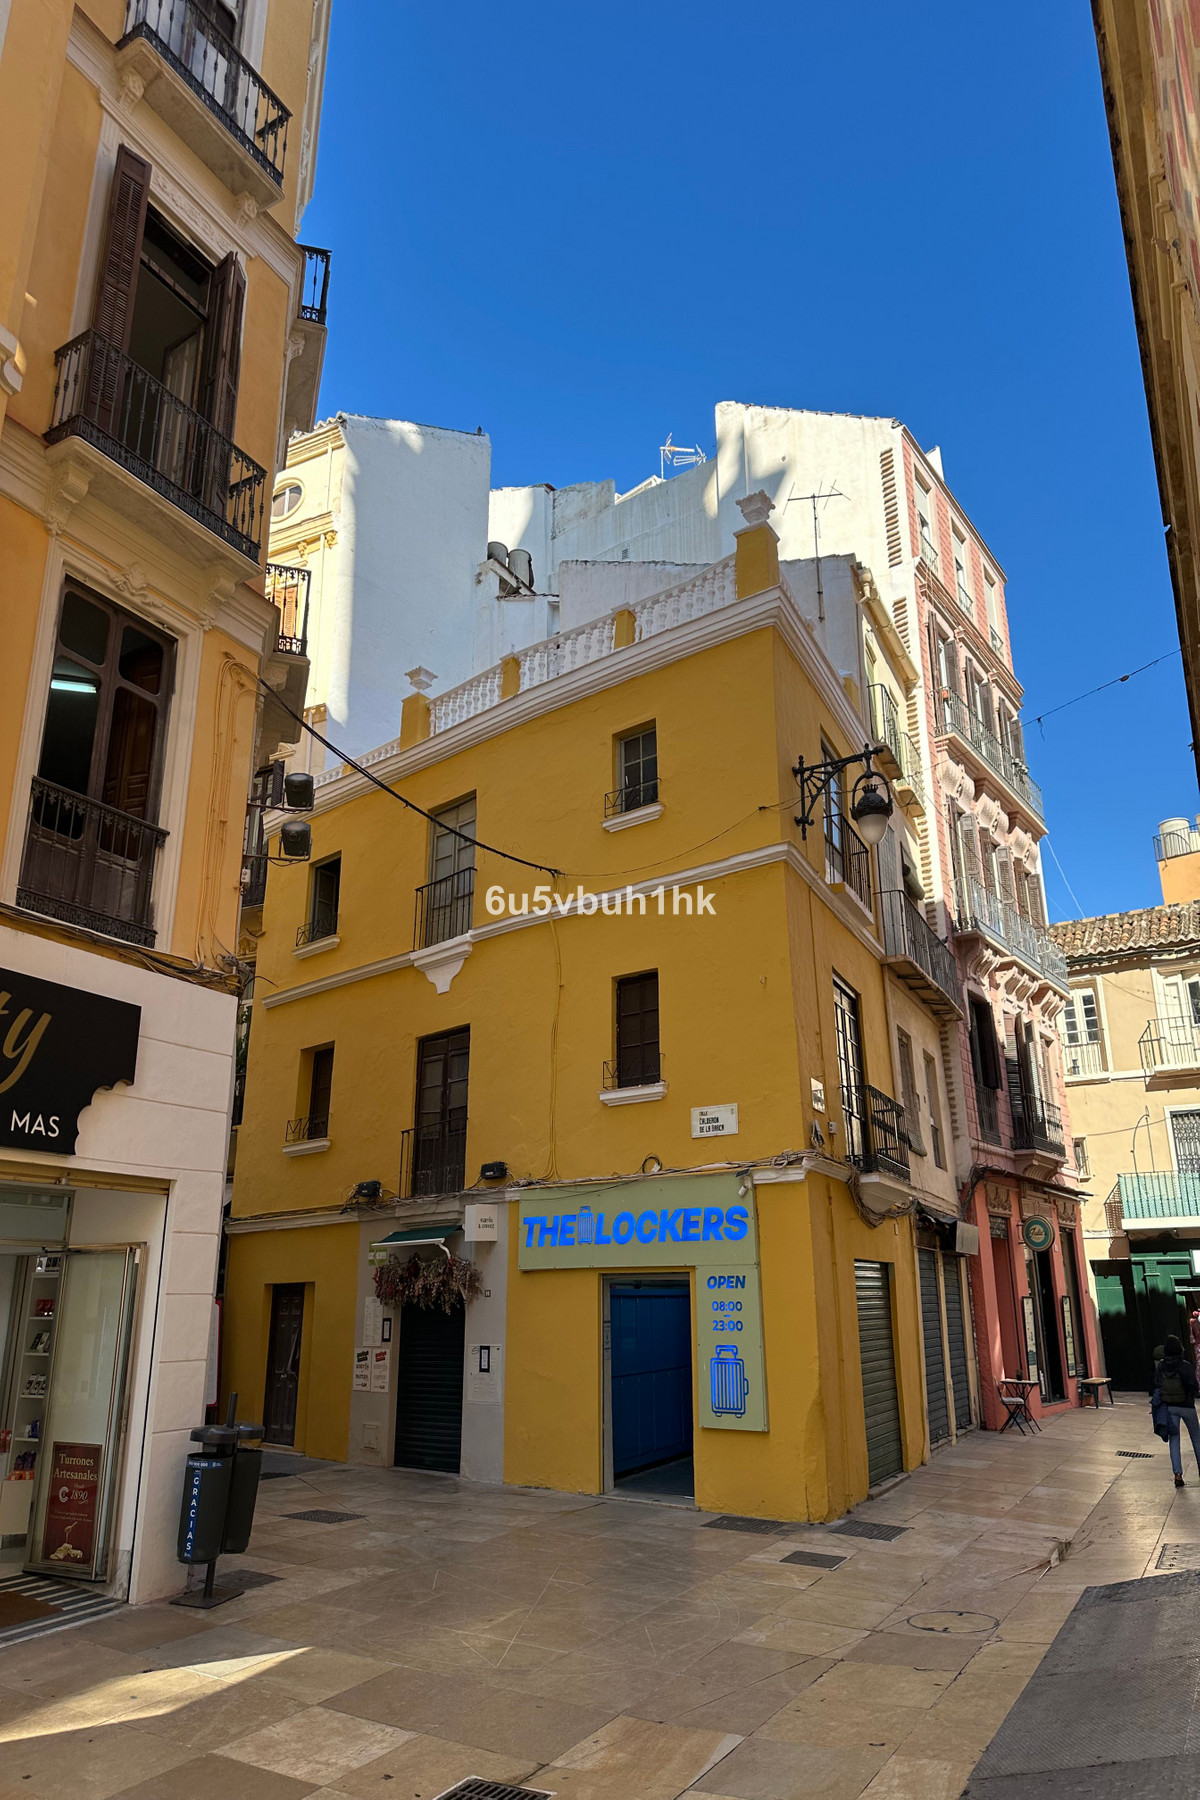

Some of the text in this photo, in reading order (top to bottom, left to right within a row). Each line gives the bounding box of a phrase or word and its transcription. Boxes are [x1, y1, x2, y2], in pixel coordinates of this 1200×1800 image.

[10, 1109, 60, 1138] MAS
[523, 1205, 749, 1247] THE LOCKERS
[707, 1275, 746, 1290] OPEN
[712, 1301, 743, 1312] 08:00
[712, 1320, 744, 1332] 23:00
[59, 1453, 94, 1466] Turrones
[53, 1467, 98, 1481] Artesanales
[70, 1489, 88, 1502] 1890
[186, 1477, 200, 1551] GRACIAS
